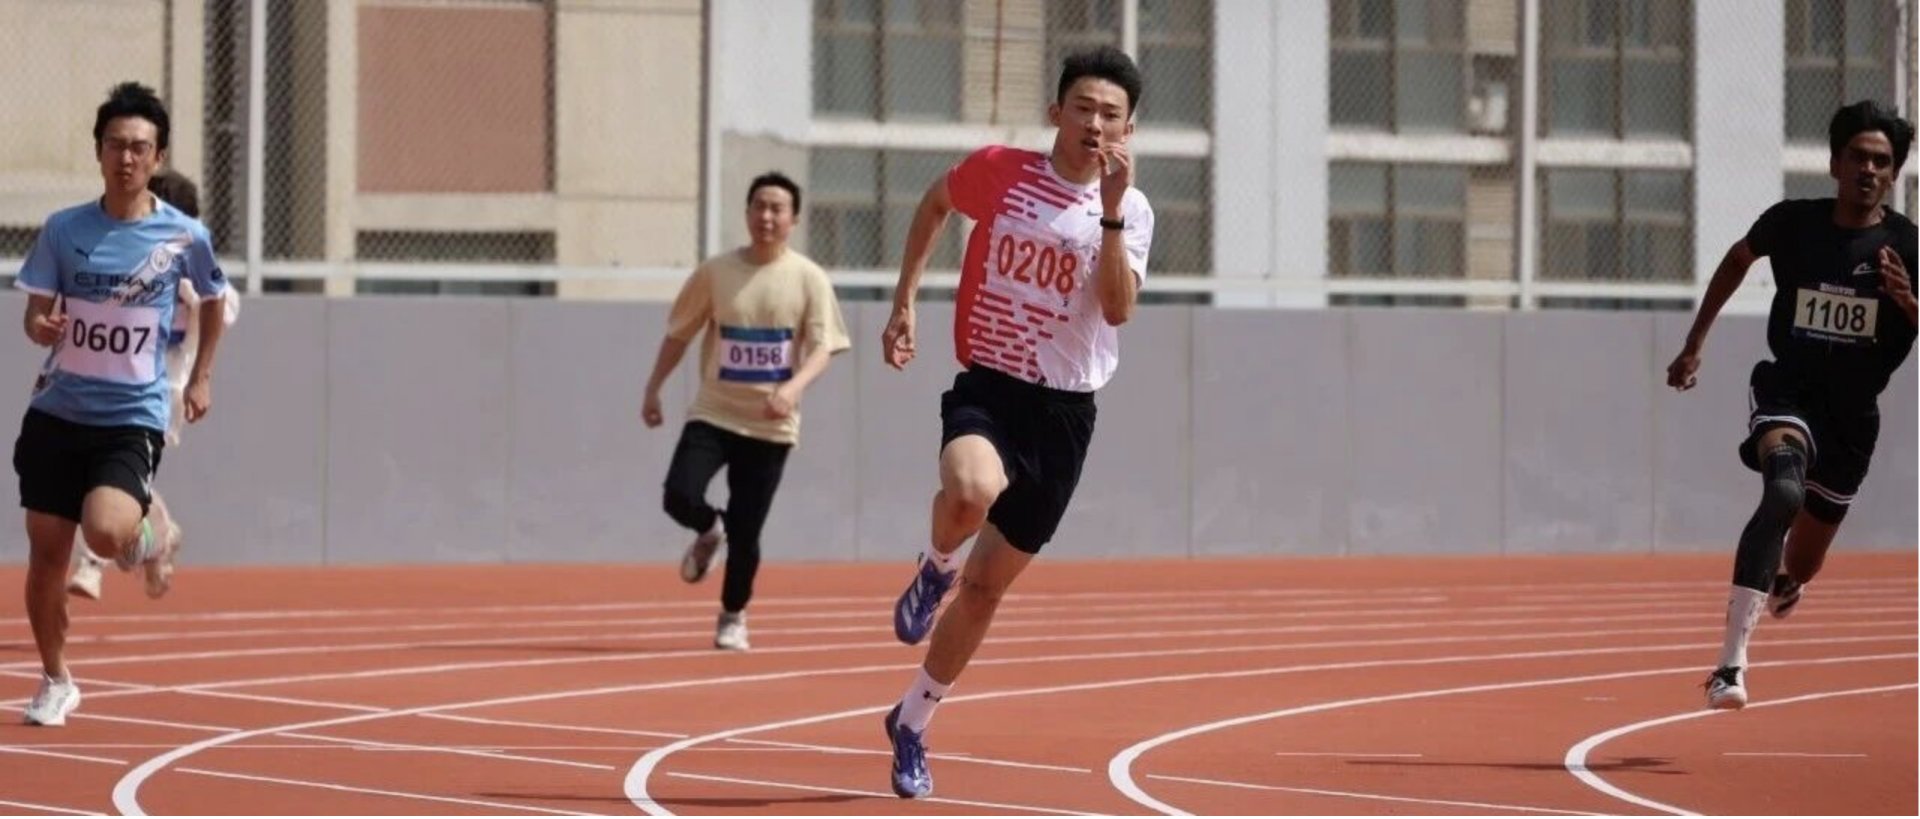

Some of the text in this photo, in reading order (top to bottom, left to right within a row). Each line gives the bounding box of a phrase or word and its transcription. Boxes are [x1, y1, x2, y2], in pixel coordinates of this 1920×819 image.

[998, 234, 1077, 294] 0208
[73, 272, 165, 294] ETIHAD
[1806, 297, 1866, 333] 1108
[73, 318, 150, 355] 0607
[729, 345, 783, 366] 0158
